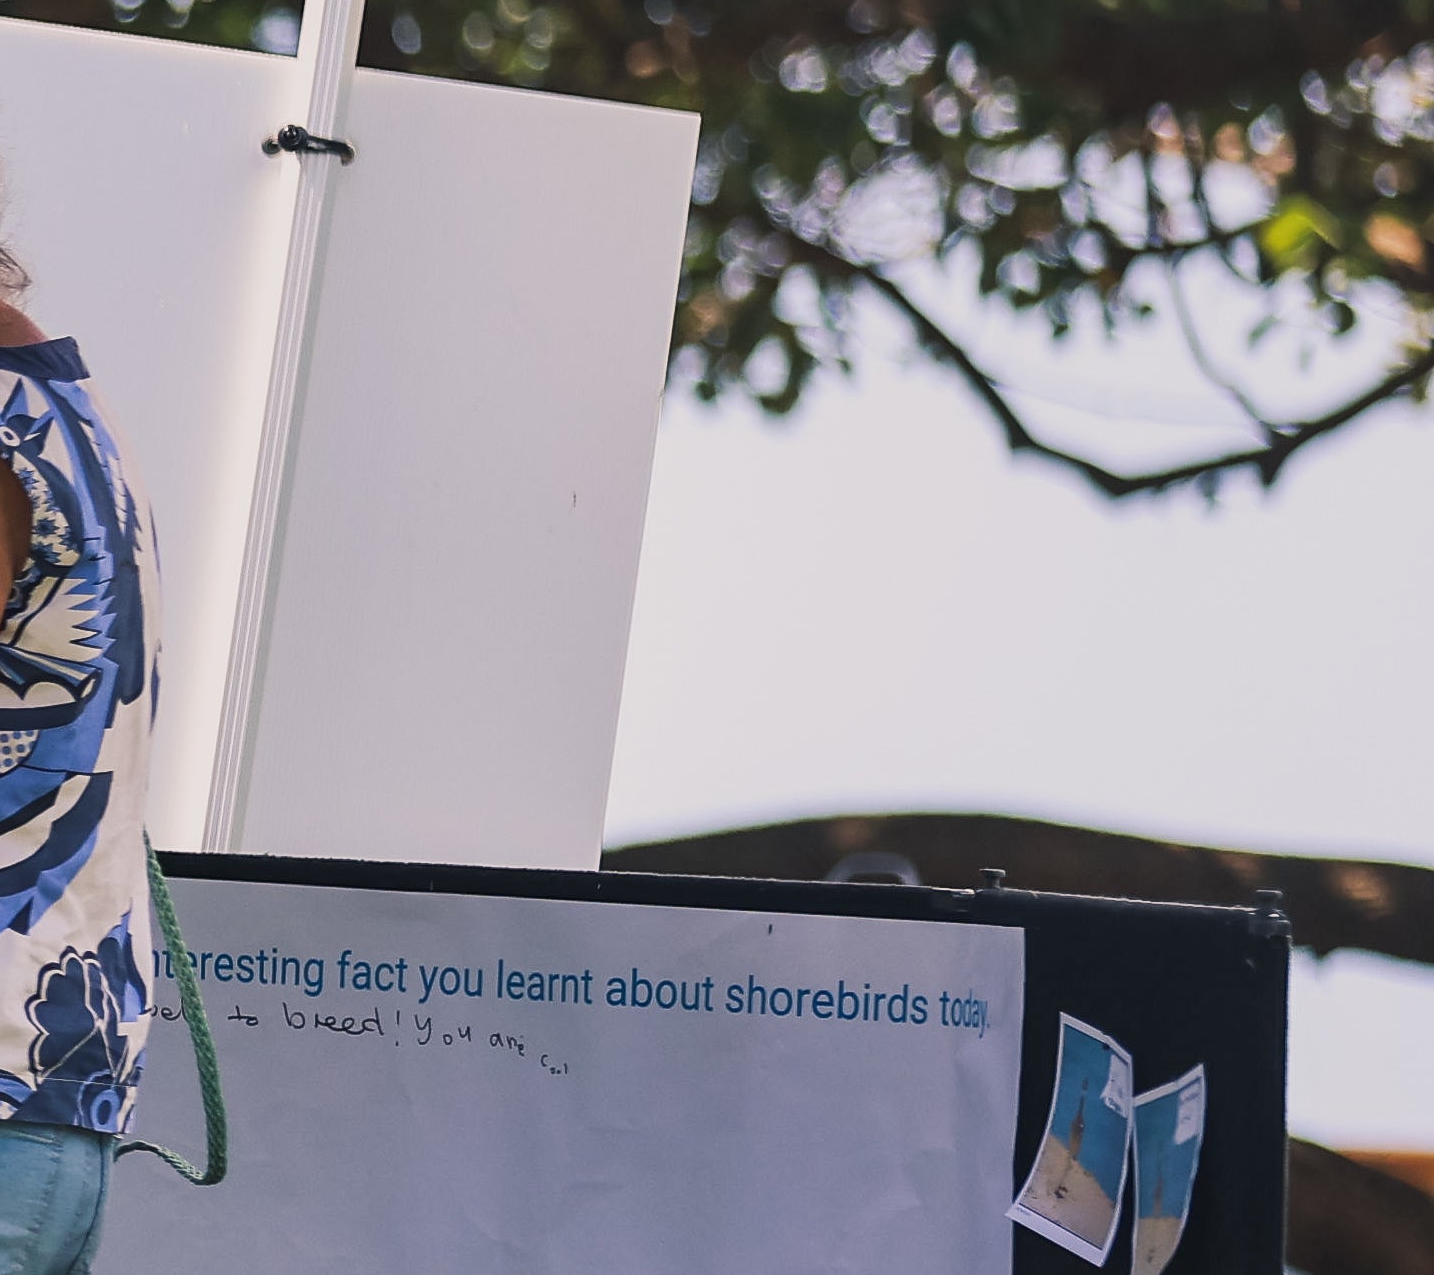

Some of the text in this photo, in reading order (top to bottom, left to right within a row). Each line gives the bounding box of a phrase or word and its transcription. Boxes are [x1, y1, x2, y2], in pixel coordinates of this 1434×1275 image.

[336, 948, 409, 993] fact
[418, 965, 484, 1004] you
[496, 958, 594, 1006] learnt
[605, 967, 715, 1013] about
[724, 973, 930, 1026] shorebirds
[227, 1004, 260, 1027] to
